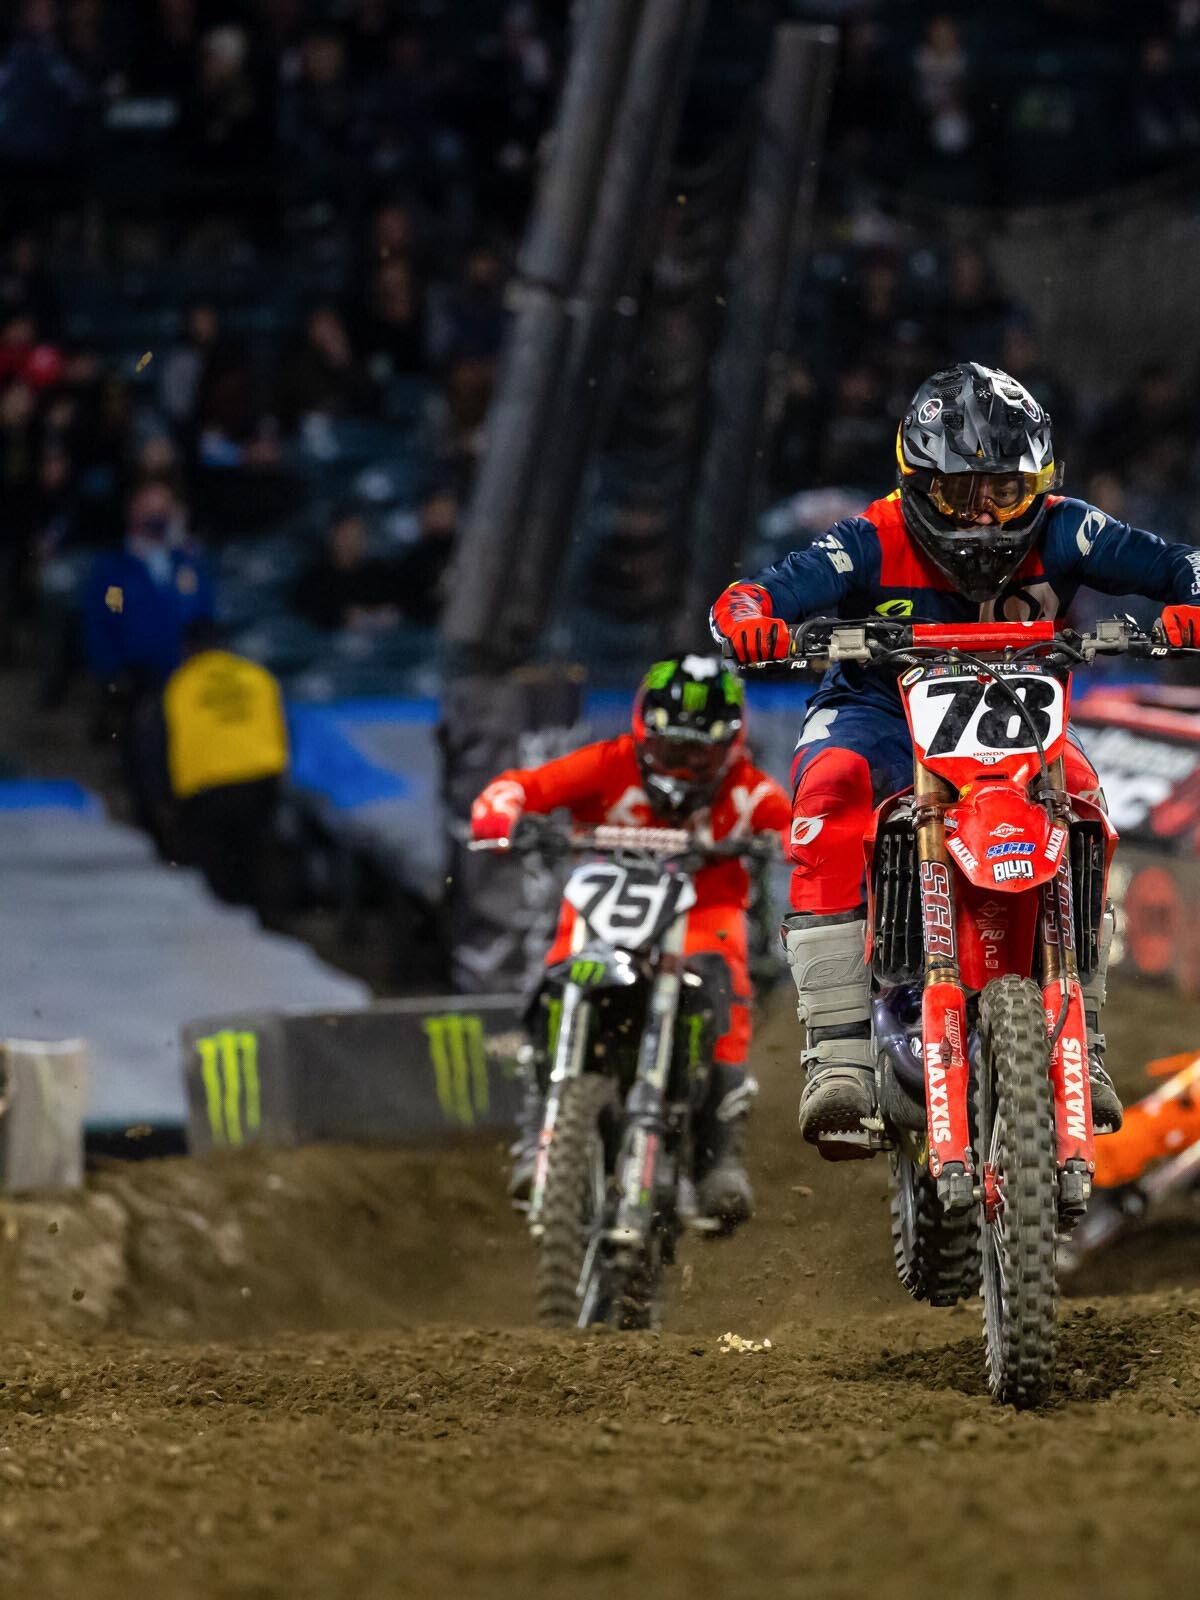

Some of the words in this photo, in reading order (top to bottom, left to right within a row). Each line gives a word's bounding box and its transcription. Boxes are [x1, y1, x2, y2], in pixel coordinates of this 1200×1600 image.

[791, 660, 807, 669] FLO
[926, 677, 1055, 757] 78
[947, 837, 979, 872] MAXXIS
[1044, 827, 1064, 863] MAXXIS
[926, 1043, 952, 1143] MAXXIS
[1062, 1037, 1087, 1141] MAXXIS
